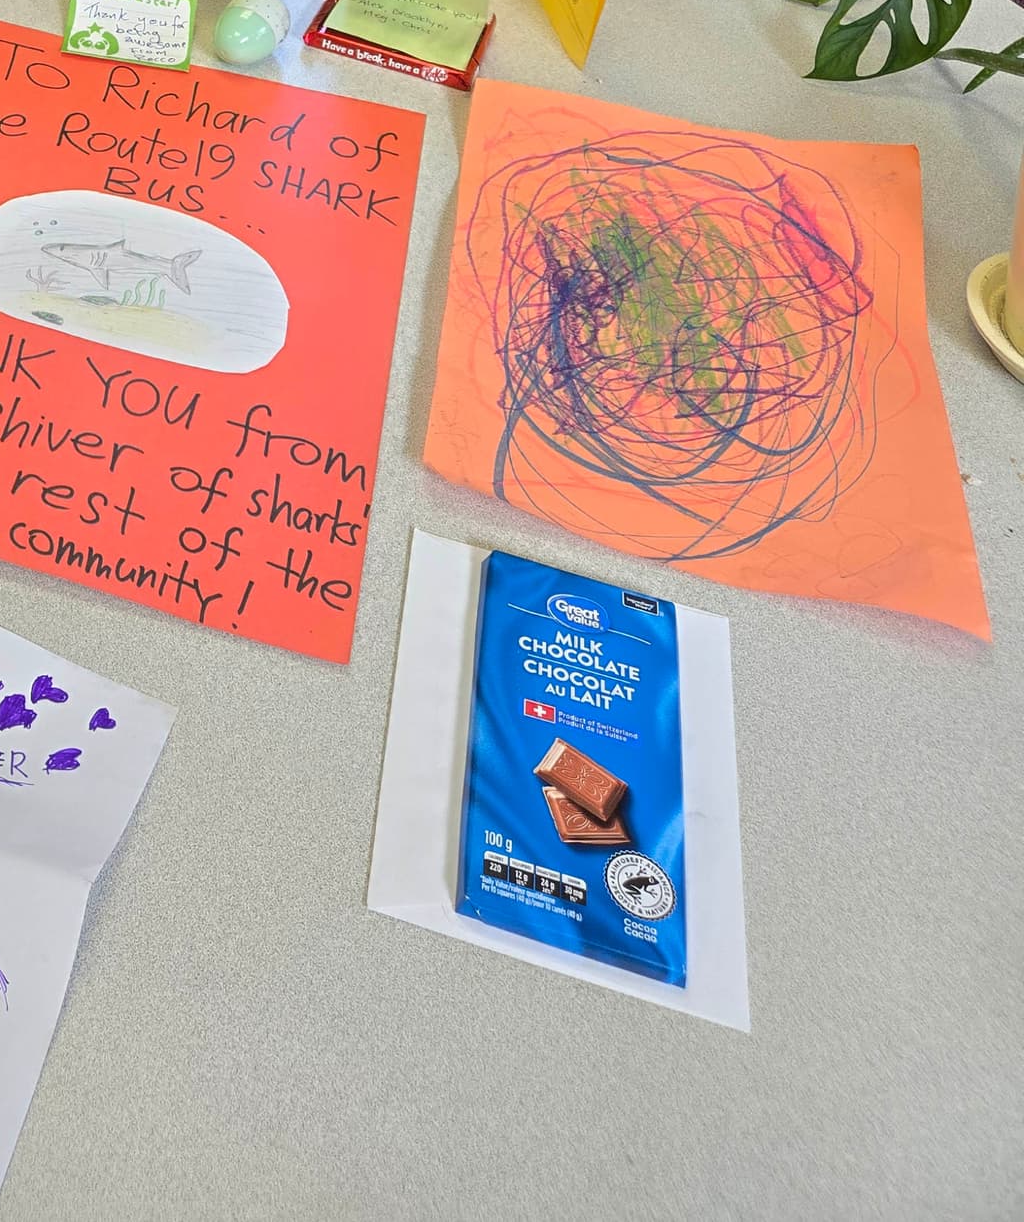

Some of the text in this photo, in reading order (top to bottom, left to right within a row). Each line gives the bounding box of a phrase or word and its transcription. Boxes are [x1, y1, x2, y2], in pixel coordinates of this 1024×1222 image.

[84, 1, 130, 21] Thank
[138, 16, 168, 30] you
[322, 38, 420, 75] Have a break, have a
[101, 62, 401, 173] Richard of
[252, 160, 401, 227] SHARK
[86, 355, 202, 431] YOU
[225, 403, 370, 494] from
[170, 465, 237, 513] of
[9, 468, 148, 536] rest
[178, 525, 243, 570] of
[267, 546, 355, 612] the
[554, 599, 600, 622] Great
[565, 612, 600, 630] Value
[555, 631, 604, 656] MILK
[518, 636, 641, 682] CHOCOLATE
[523, 659, 636, 701] CHOCOLAT
[545, 683, 613, 711] AU LAIT
[558, 711, 639, 740] Product of Switzerland
[558, 717, 628, 743] Produit de la Suisse
[485, 830, 513, 854] 100 g
[489, 862, 502, 873] 220
[515, 870, 522, 880] 12
[609, 857, 672, 900] RAINFOREST ALLIANCE
[481, 882, 490, 891] Per
[540, 877, 549, 888] 24
[645, 902, 670, 917] NATURE
[623, 917, 658, 936] Cocoa
